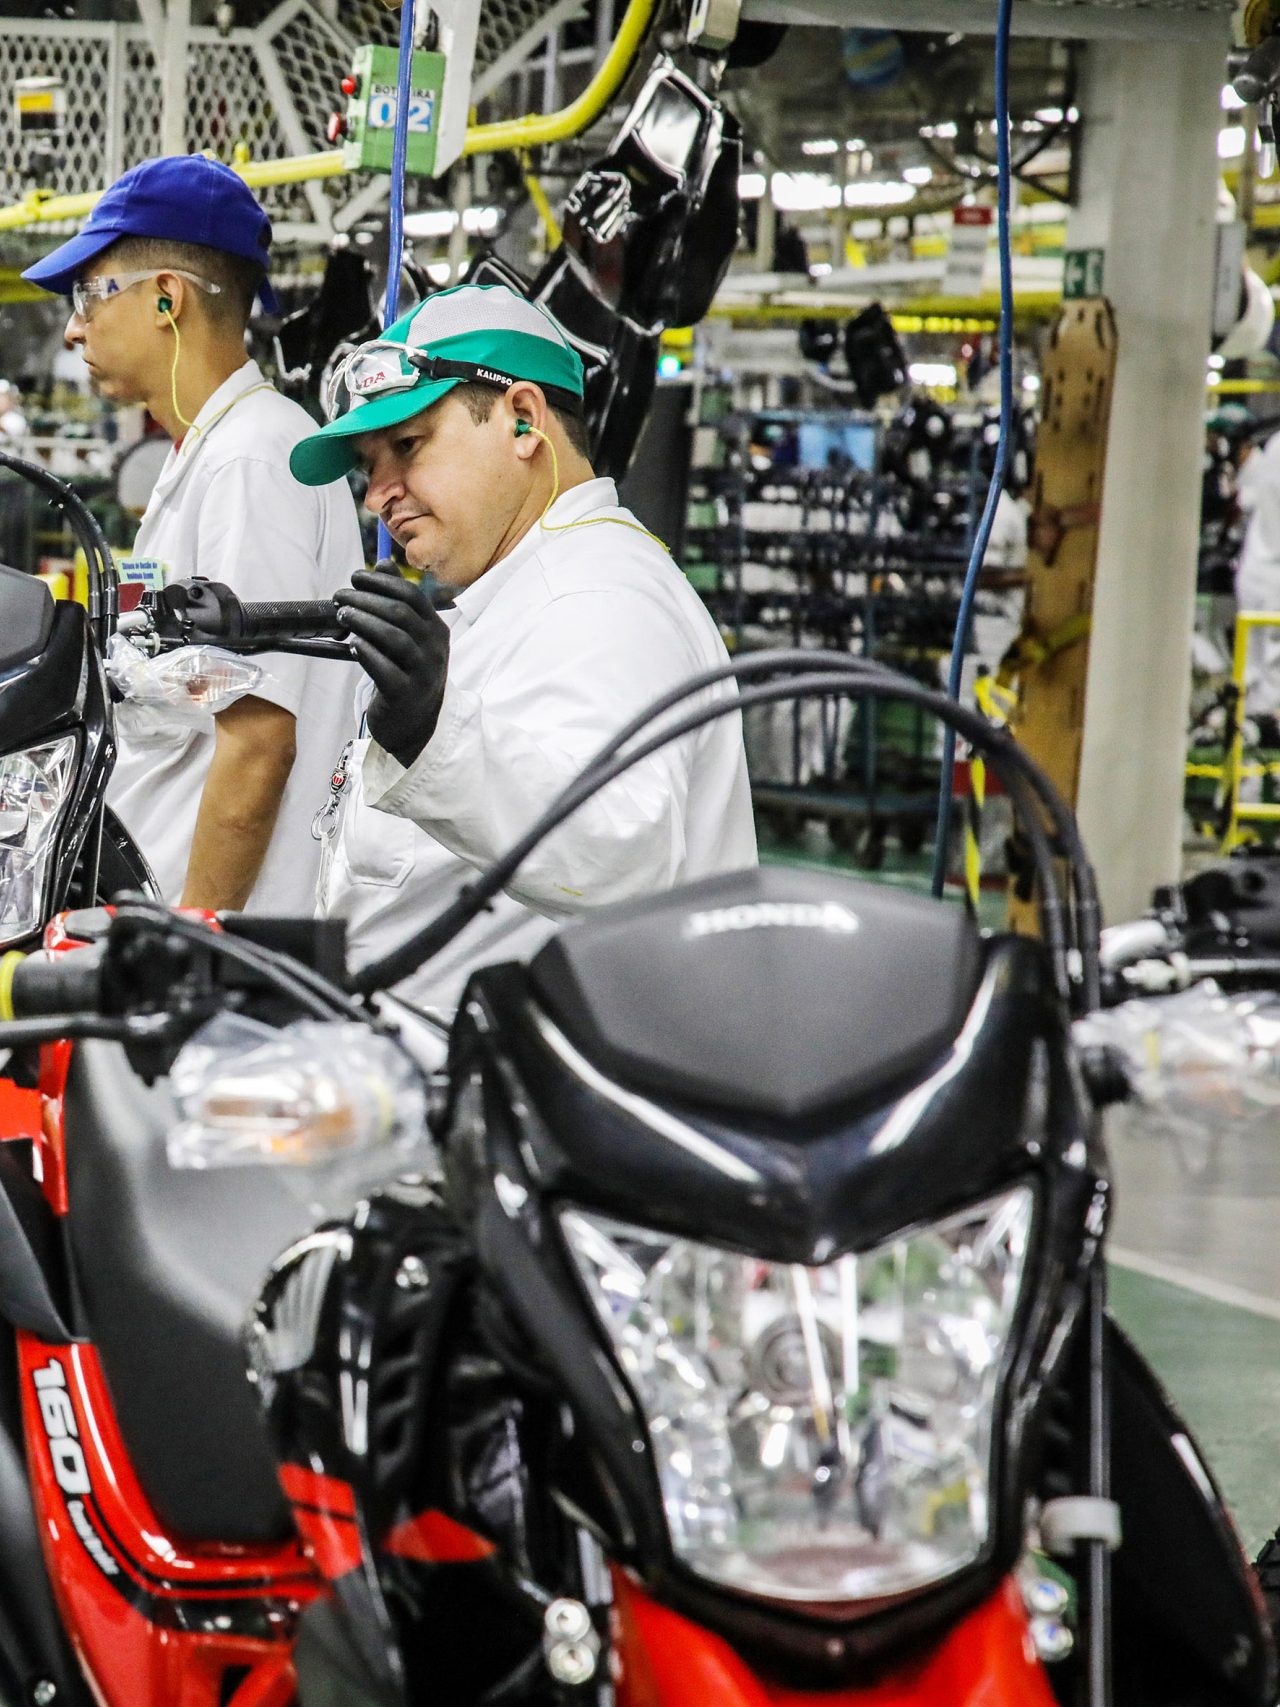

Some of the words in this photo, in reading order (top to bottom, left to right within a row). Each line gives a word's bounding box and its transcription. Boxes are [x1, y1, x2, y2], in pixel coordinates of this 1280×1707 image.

[374, 86, 432, 98] BOTIRA
[370, 97, 430, 131] 02
[476, 368, 513, 385] KALIPSO
[683, 902, 860, 939] HONDA
[32, 1357, 92, 1494] 160
